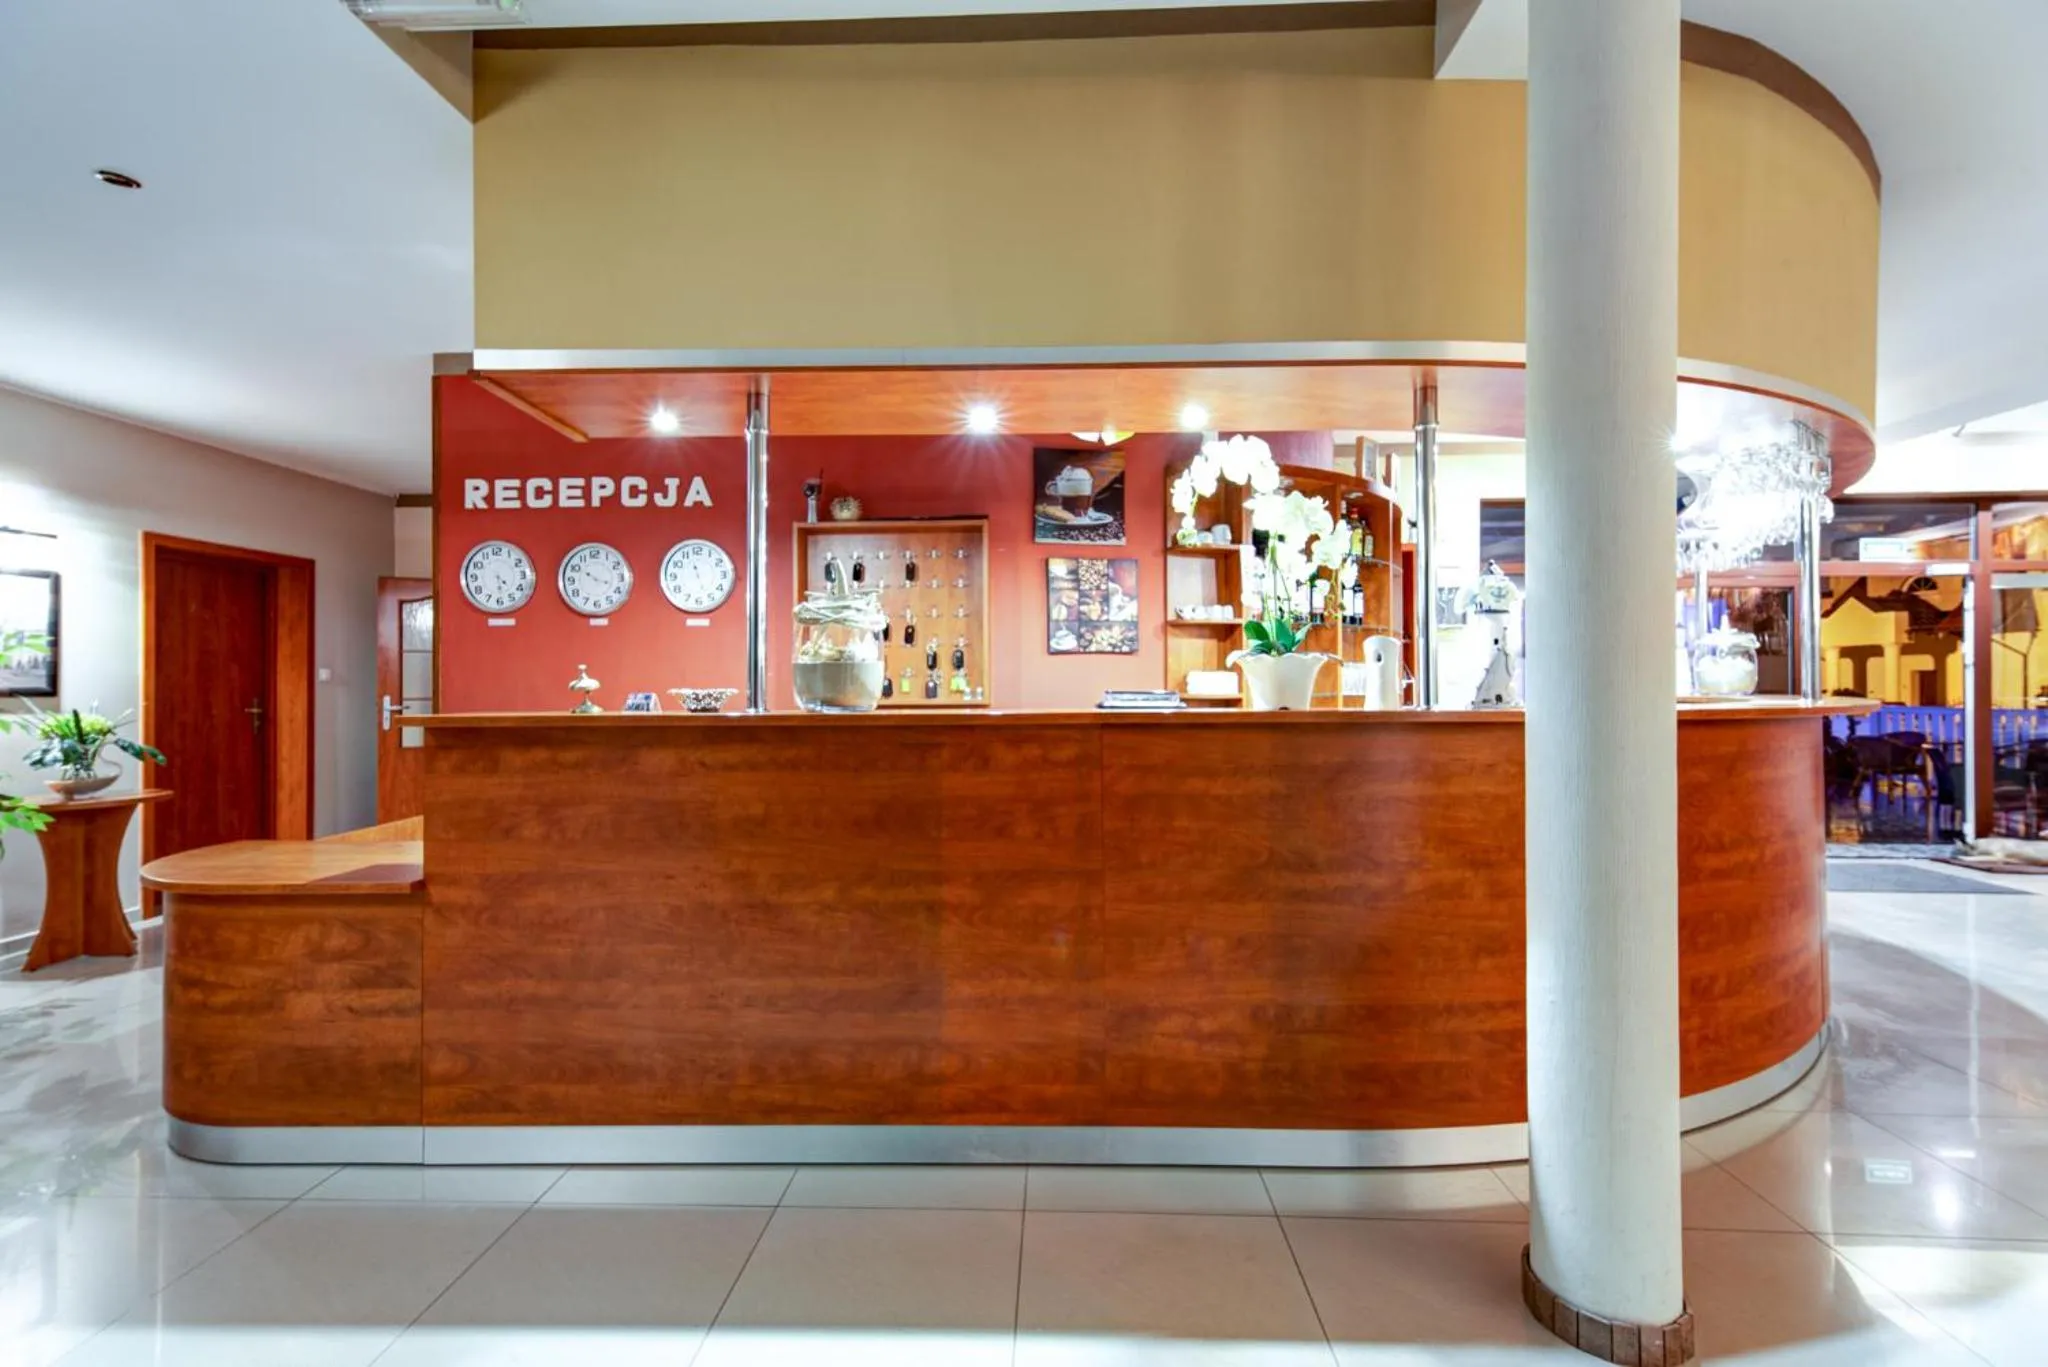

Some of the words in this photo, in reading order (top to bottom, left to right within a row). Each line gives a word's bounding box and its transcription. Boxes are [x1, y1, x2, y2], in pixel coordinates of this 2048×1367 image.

[464, 476, 713, 509] RECEPCJA
[492, 547, 502, 556] 12
[590, 550, 600, 560] 12
[682, 550, 690, 560] 11
[692, 546, 703, 556] 12
[482, 552, 490, 560] 11
[580, 554, 586, 563] 11
[473, 561, 484, 570] 10
[570, 564, 580, 572] 10
[672, 560, 684, 568] 10
